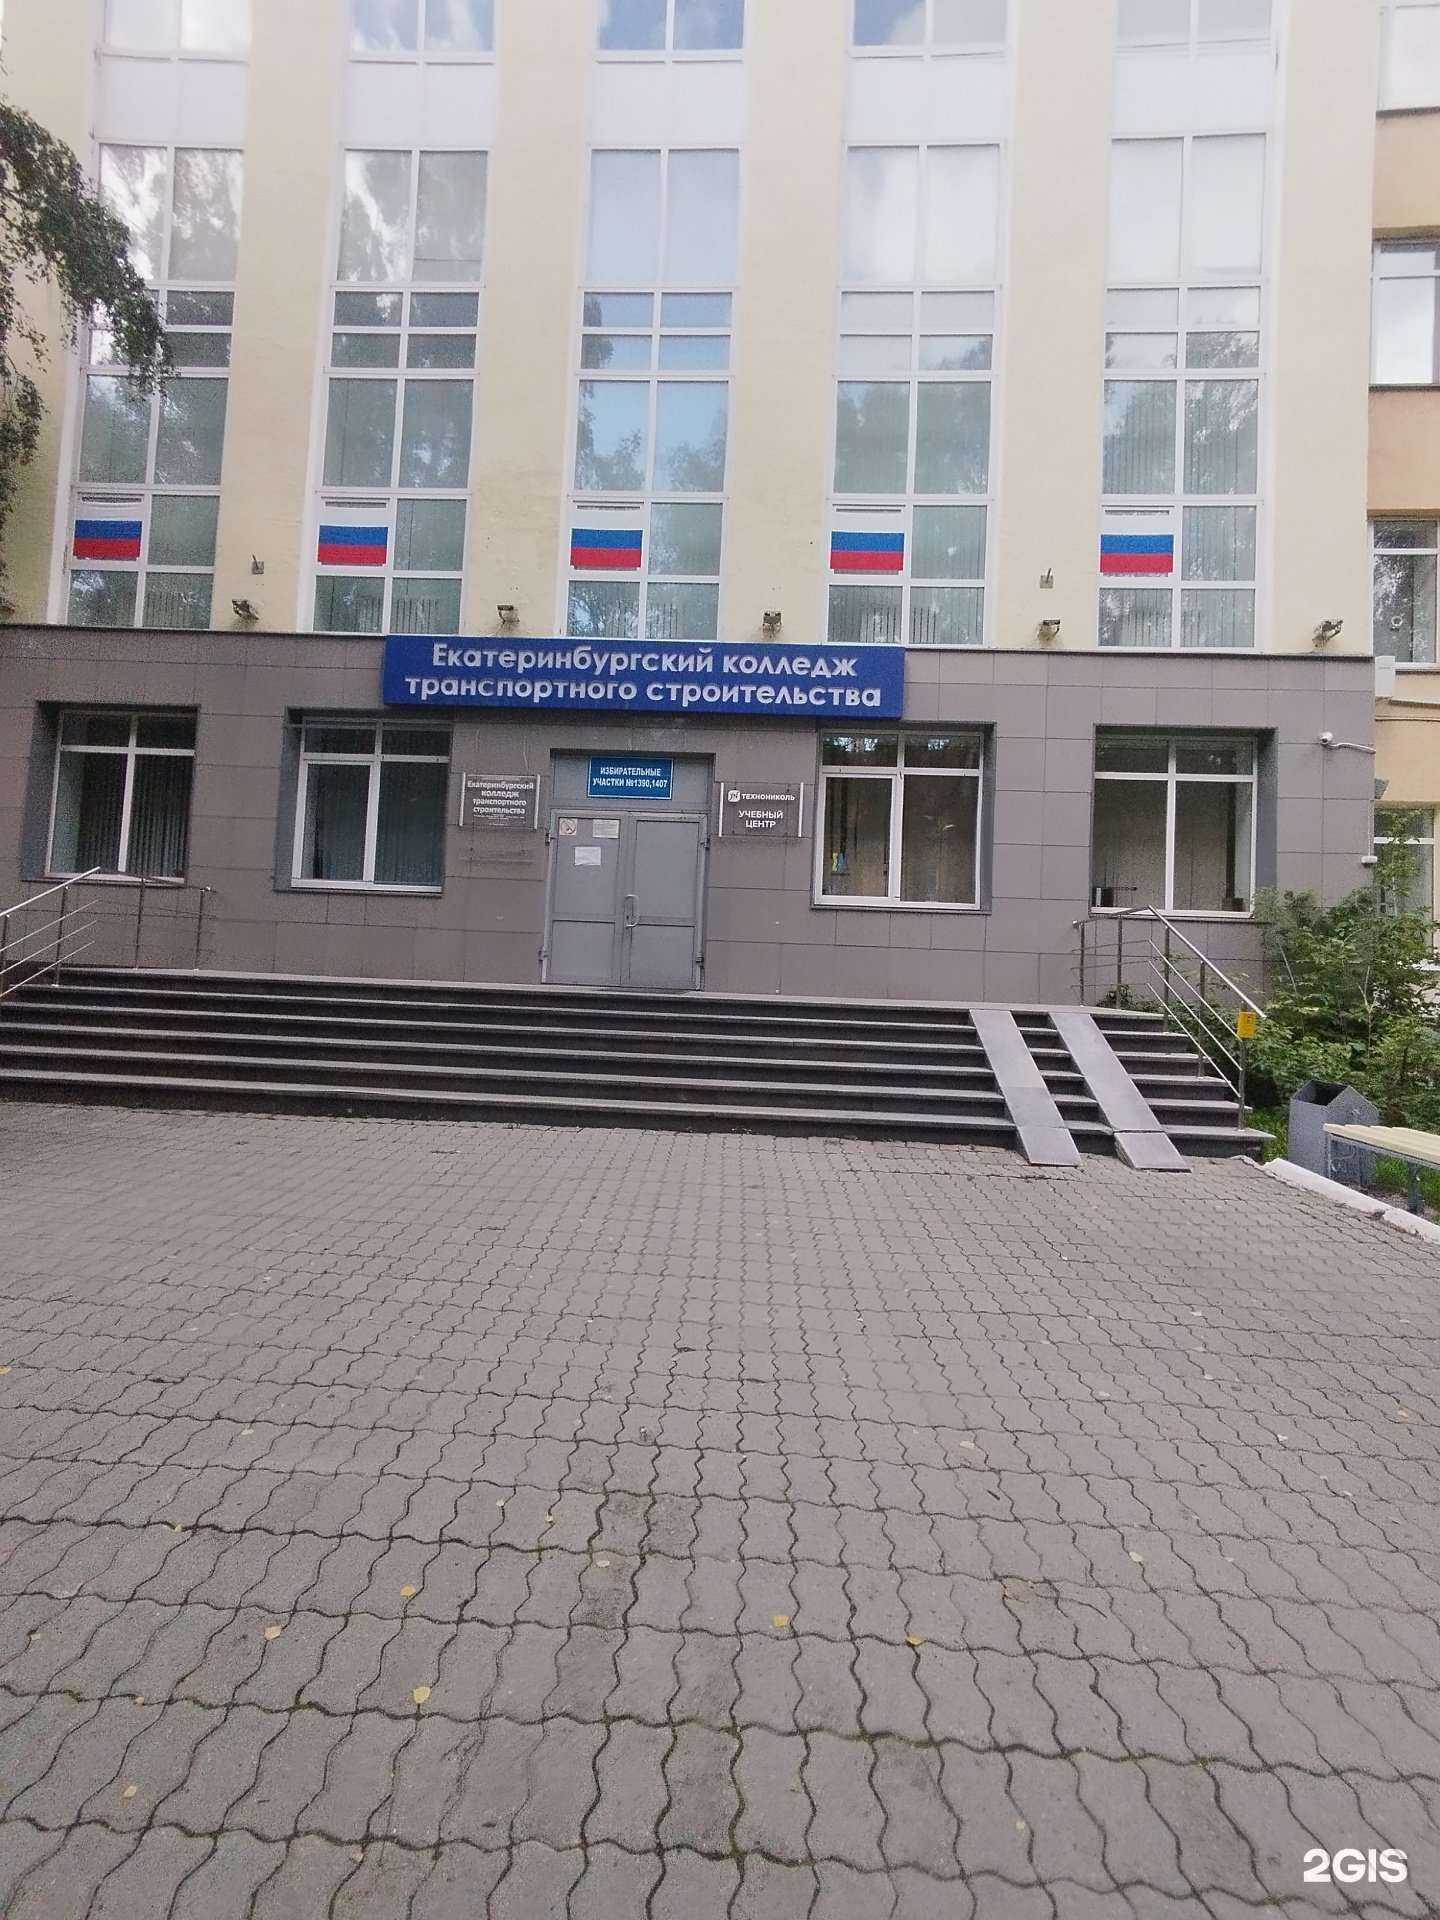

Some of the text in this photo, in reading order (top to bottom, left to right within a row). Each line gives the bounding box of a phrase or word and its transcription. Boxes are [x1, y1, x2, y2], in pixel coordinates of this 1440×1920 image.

[432, 643, 858, 678] Екатеринбургский колледж
[404, 676, 882, 707] транспортного строительства
[600, 766, 662, 777] ИЗБИРАТЕЛЬНЫЕ
[467, 780, 534, 790] Екатеринбургский
[592, 777, 625, 787] УЧАСТКИ
[481, 790, 520, 799] колледж
[741, 792, 796, 801] ТЕХНОНИКОЛЬ
[472, 798, 527, 807] транспортного
[473, 806, 526, 815] строительства
[738, 809, 784, 819] УЧЕБНЫЙ
[745, 819, 777, 829] ЦЕНТР
